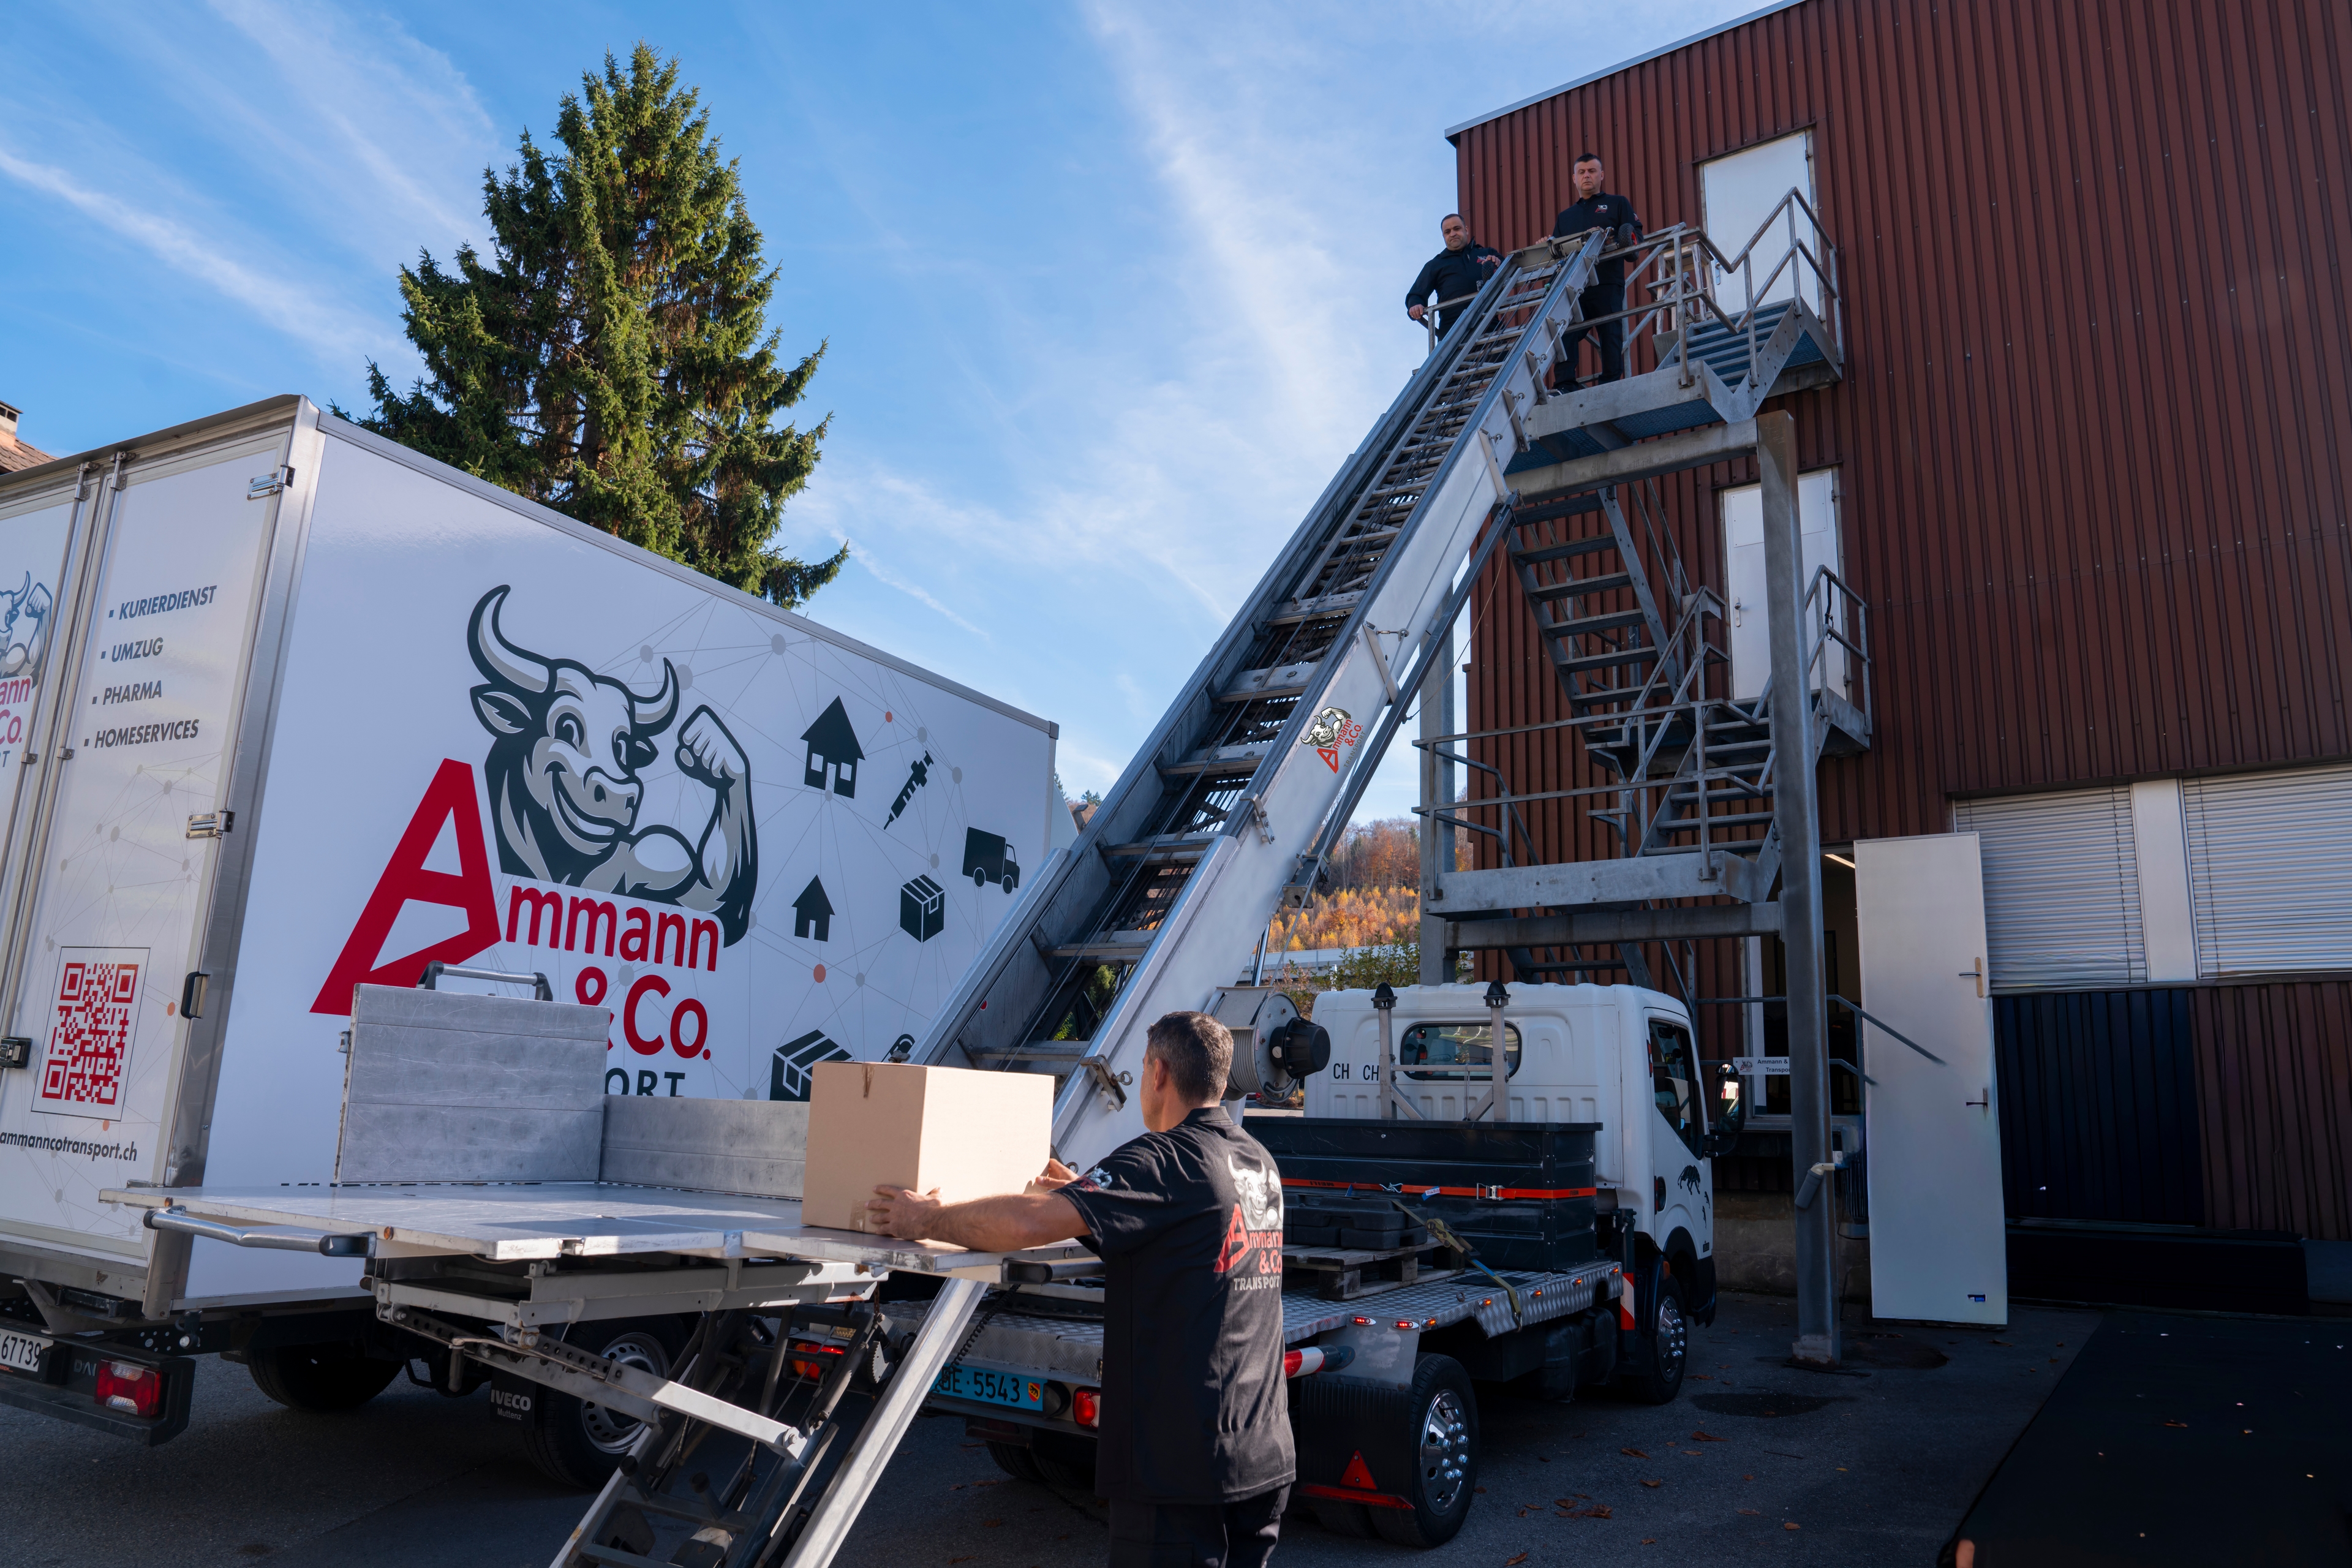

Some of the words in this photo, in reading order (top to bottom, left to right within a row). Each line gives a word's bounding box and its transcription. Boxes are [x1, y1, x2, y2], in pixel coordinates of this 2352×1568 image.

[119, 585, 217, 620] KURIERDIENST
[111, 637, 164, 662] UMZUG
[0, 677, 31, 705] ann
[102, 680, 162, 705] PHARMA
[0, 709, 22, 745] Co.
[94, 719, 199, 748] HOMESERVICES
[1317, 718, 1353, 774] Ammann
[1343, 731, 1366, 767] TRANSPORT
[309, 758, 719, 1017] Ammann
[1333, 1063, 1349, 1079] CH
[1363, 1065, 1379, 1081] CH
[0, 1132, 137, 1161] ammanncotransport.ch
[0, 1334, 42, 1368] 67739
[74, 1359, 97, 1376] DAI
[491, 1389, 531, 1411] IVECO
[497, 1408, 522, 1420] Muttenz
